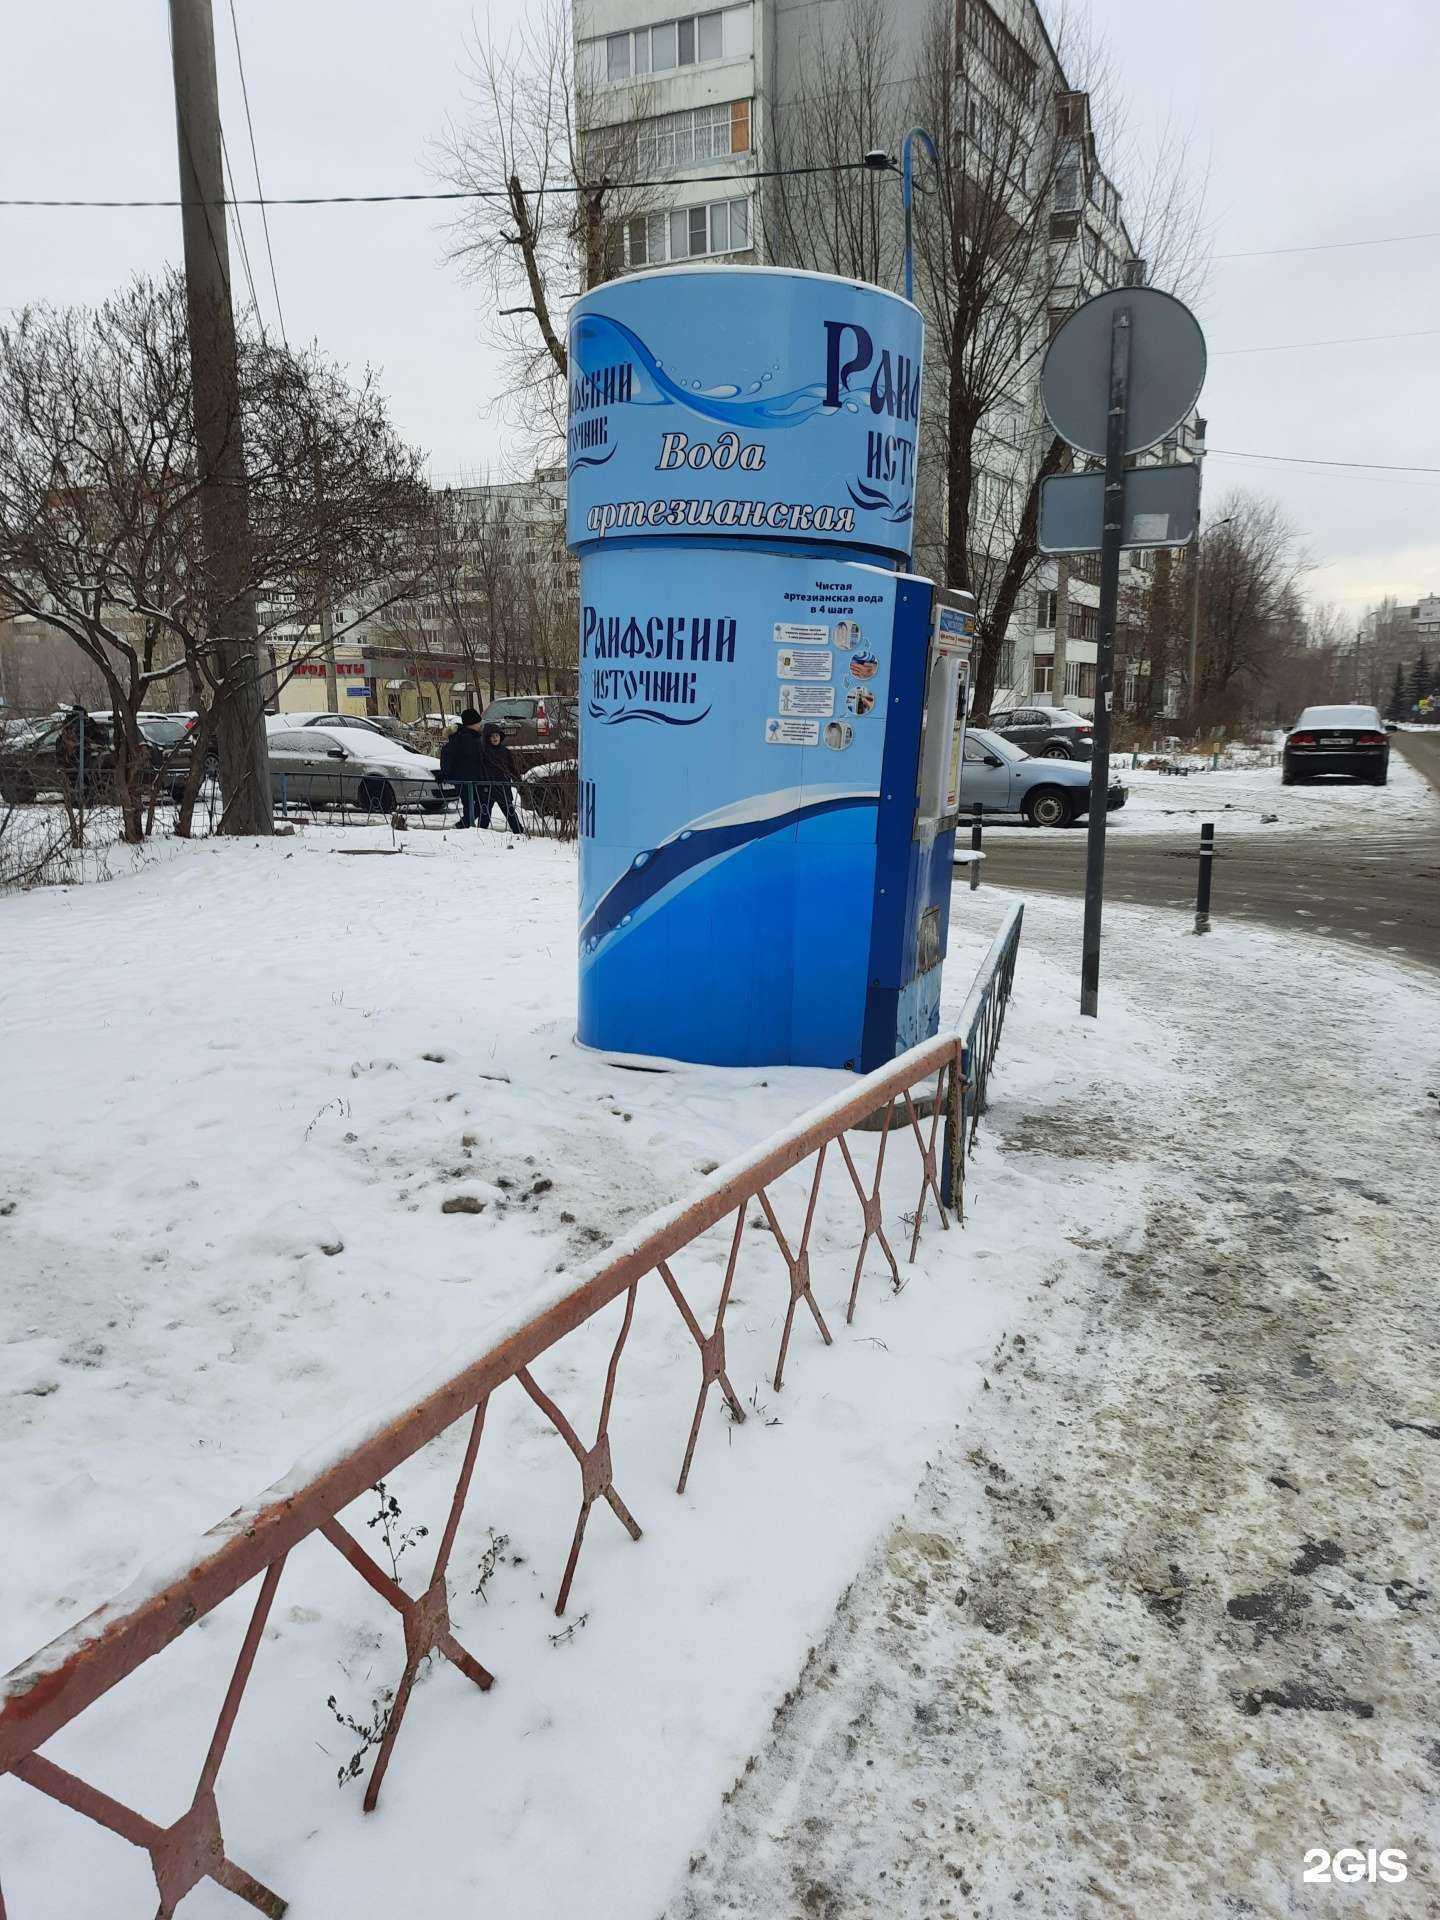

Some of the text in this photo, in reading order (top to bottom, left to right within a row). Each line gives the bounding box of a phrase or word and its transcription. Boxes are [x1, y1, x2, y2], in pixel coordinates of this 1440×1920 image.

[655, 431, 766, 471] Вода
[587, 499, 856, 538] артезианская
[815, 581, 852, 591] Чистая
[783, 592, 884, 604] артезианская вода
[810, 604, 854, 616] в 4 шага
[293, 663, 365, 677] ПРОДКТЫ
